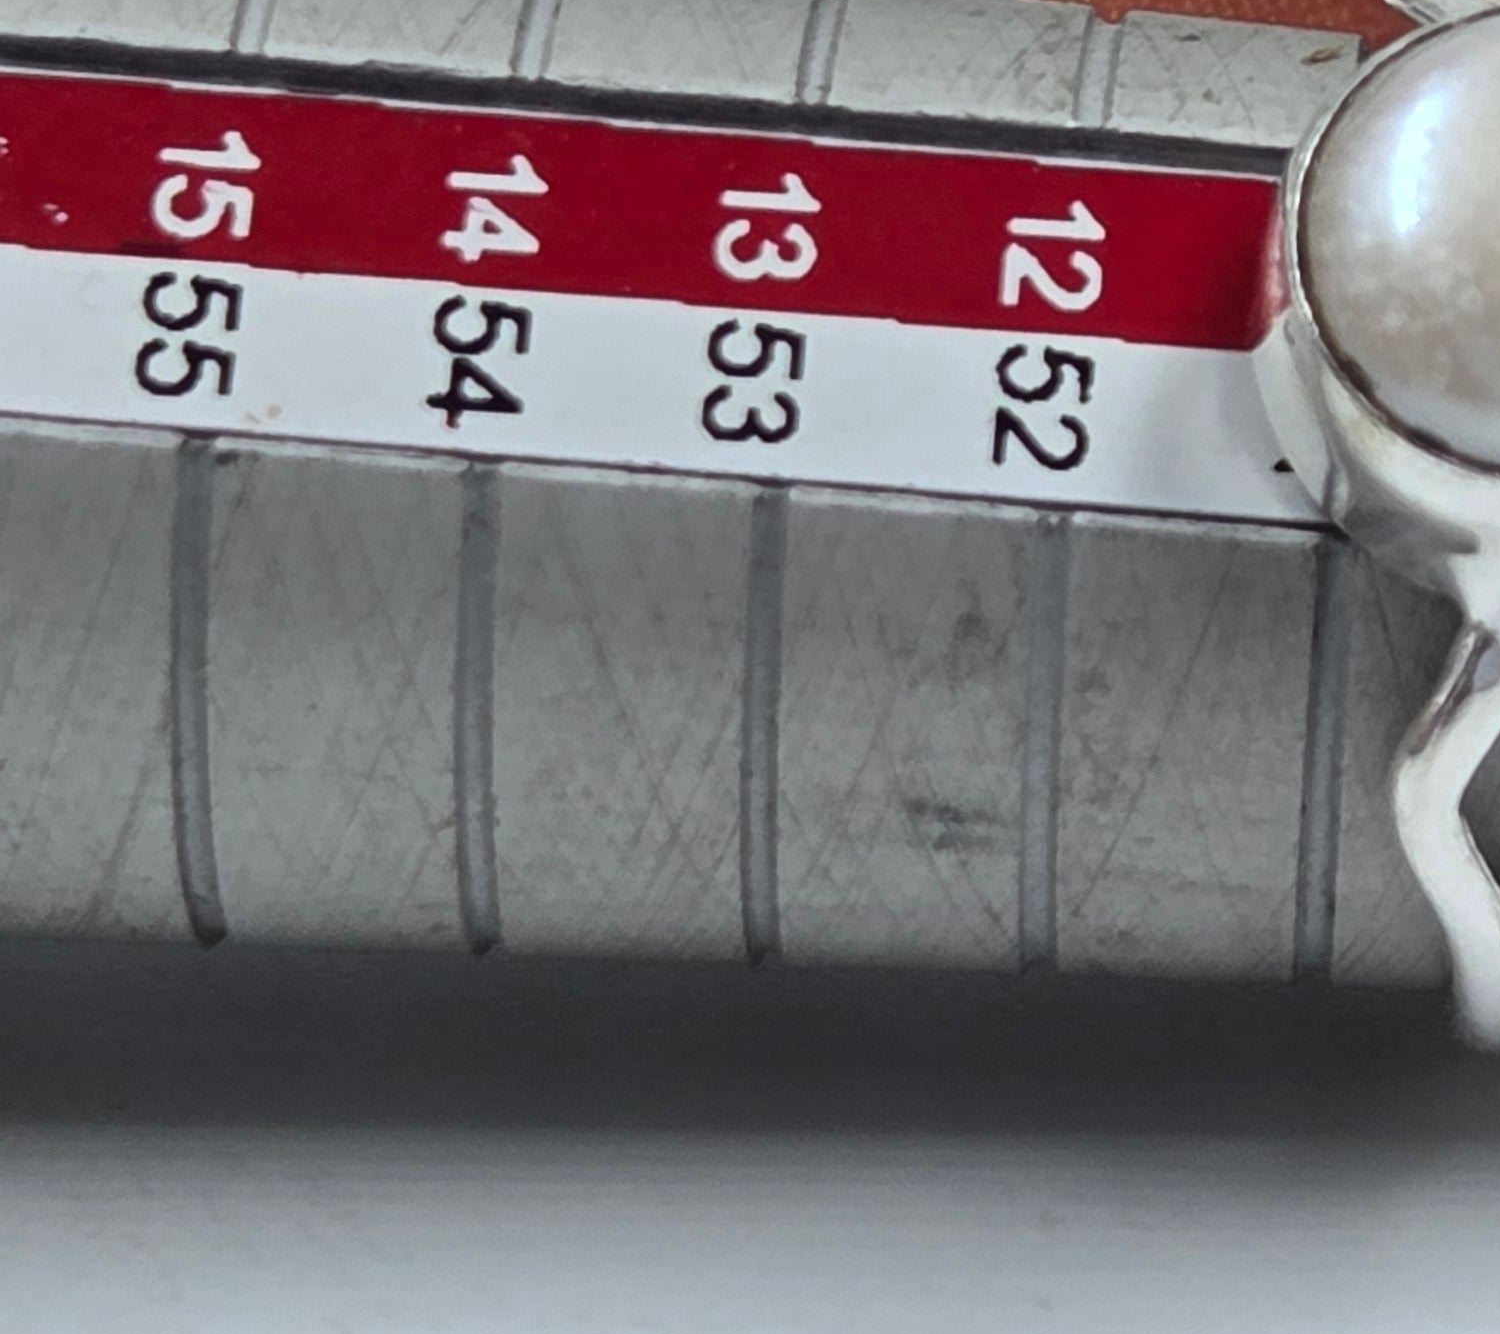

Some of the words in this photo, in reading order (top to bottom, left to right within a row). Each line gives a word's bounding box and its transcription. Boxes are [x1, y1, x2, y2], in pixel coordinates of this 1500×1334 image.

[152, 130, 261, 239] 15
[441, 154, 549, 262] 14
[714, 172, 822, 281] 13
[1000, 200, 1106, 311] 12
[135, 272, 242, 397] 55
[425, 295, 531, 428] 54
[701, 320, 804, 444] 53
[992, 344, 1094, 471] 52
